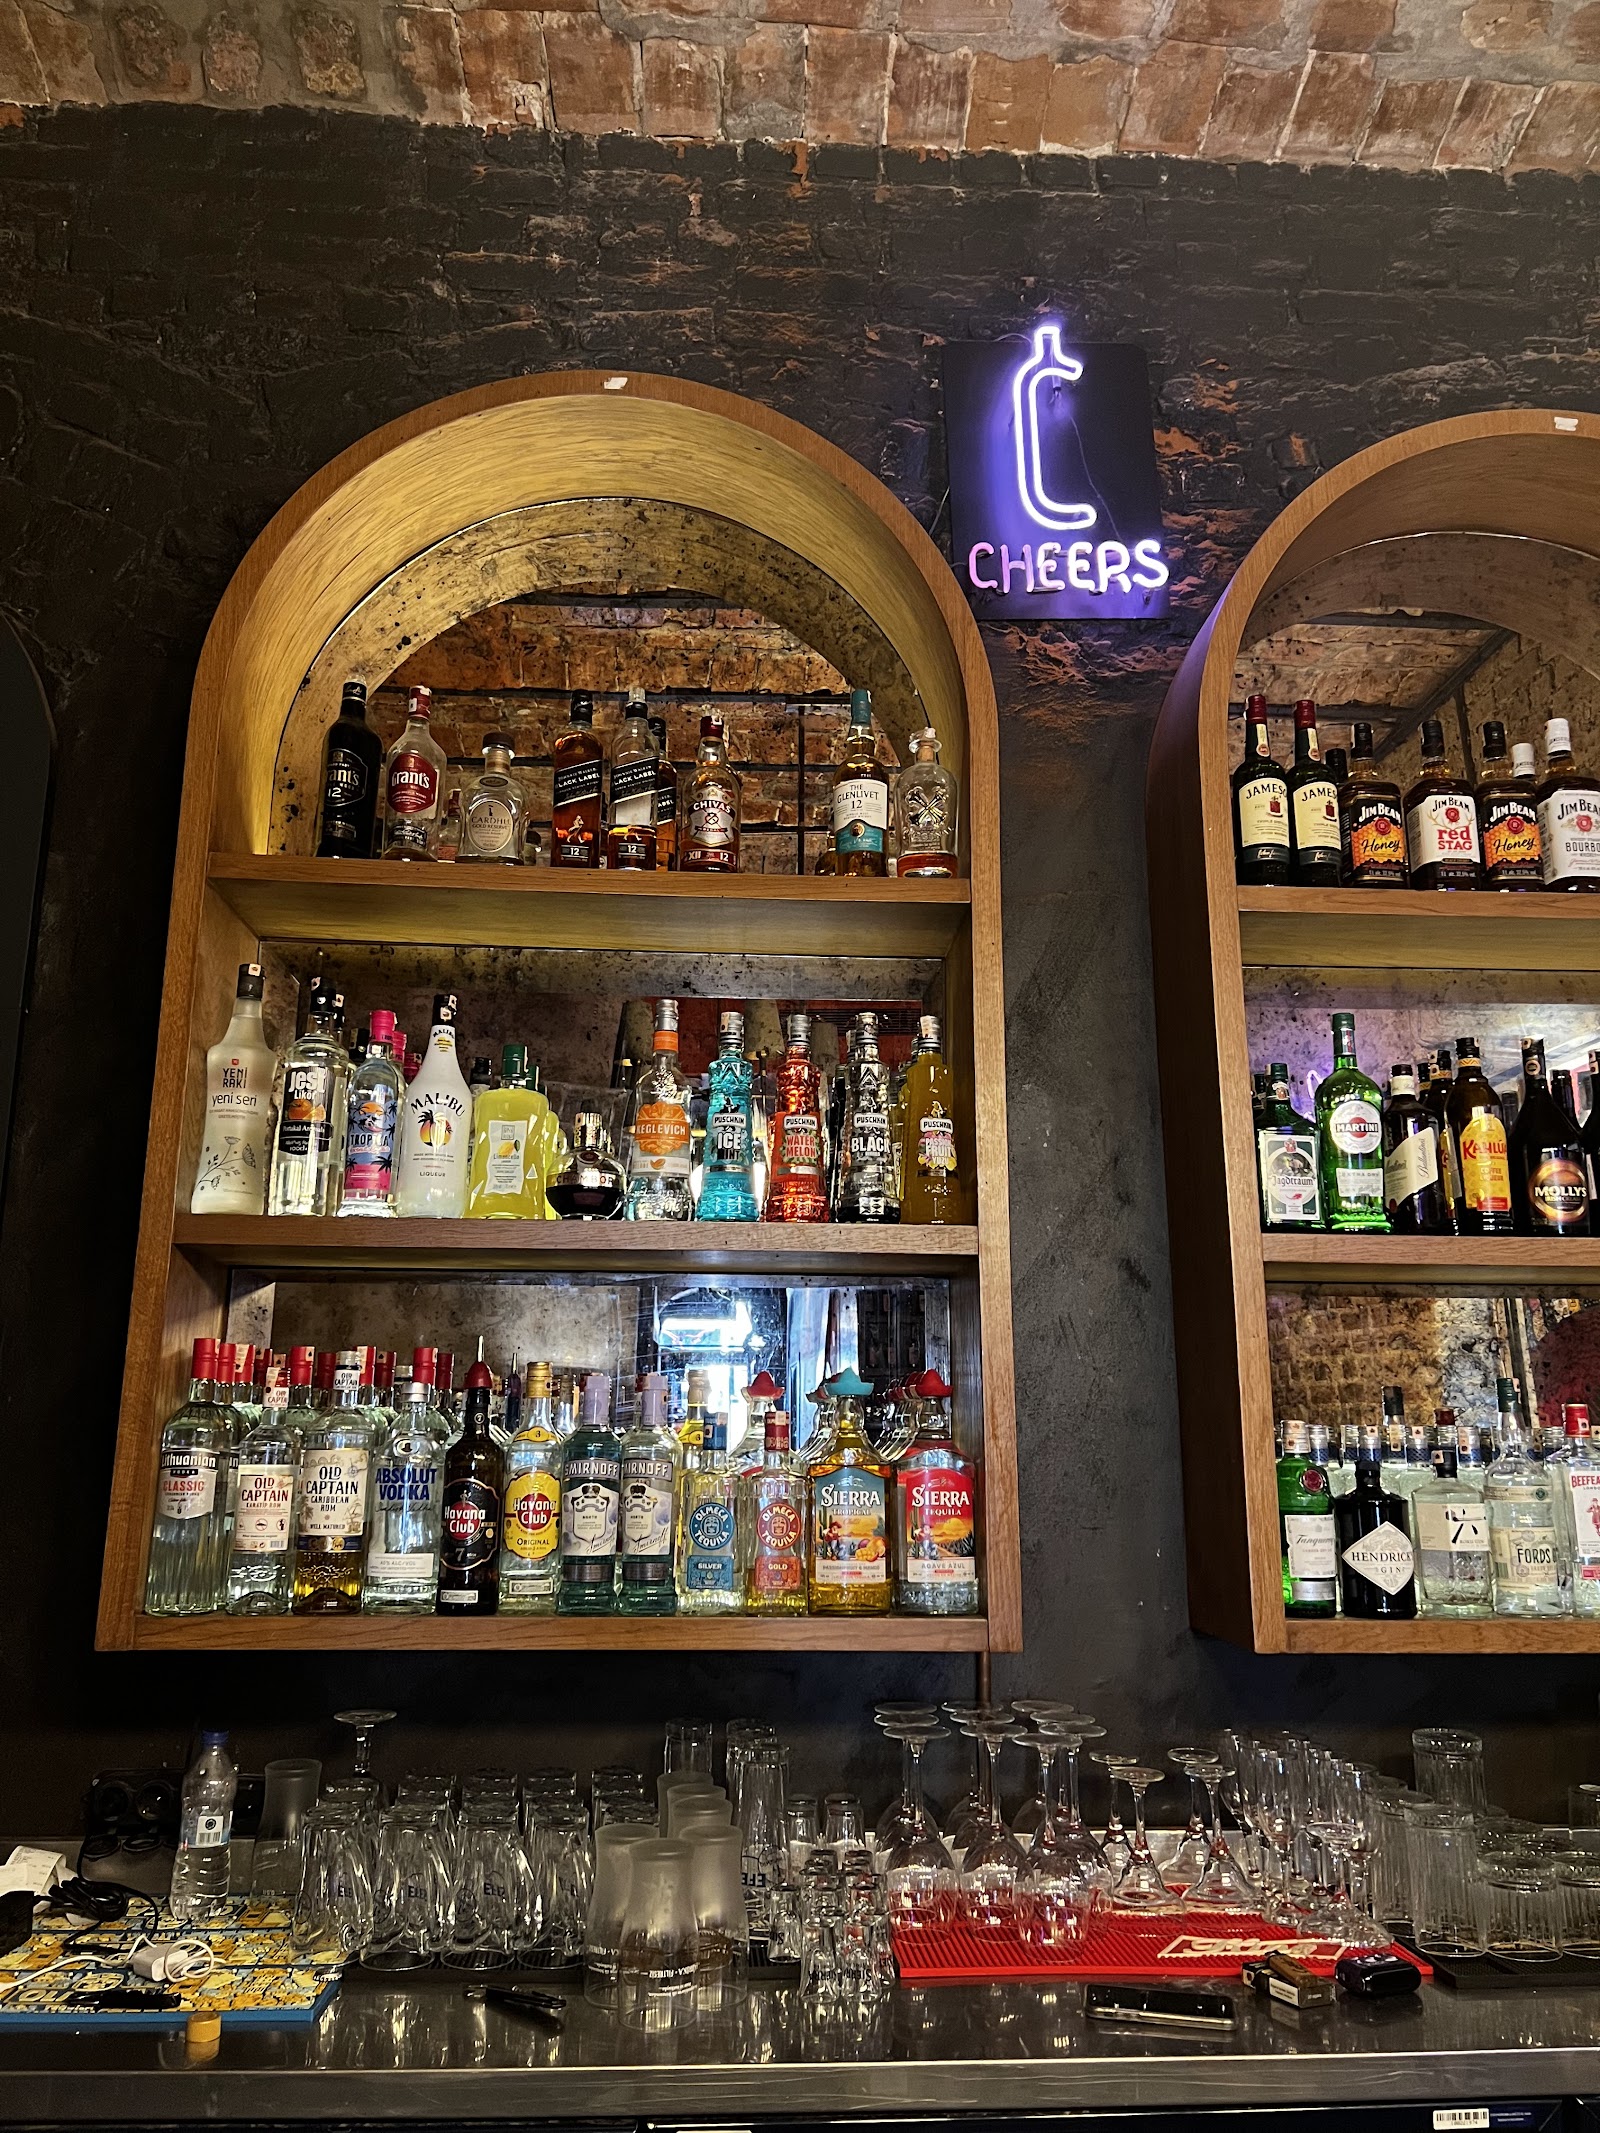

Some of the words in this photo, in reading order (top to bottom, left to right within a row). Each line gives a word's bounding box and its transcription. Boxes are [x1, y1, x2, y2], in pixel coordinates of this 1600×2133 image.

[968, 540, 1168, 593] CHEERS
[329, 769, 359, 787] ant's
[578, 772, 601, 783] LABEL
[633, 769, 657, 780] LABEL
[850, 783, 864, 791] THE
[657, 799, 675, 808] ABEL
[837, 790, 880, 804] GLENLIVET
[851, 799, 863, 810] 12
[692, 800, 732, 814] CHIVAS
[1432, 799, 1450, 813] JIM
[1450, 797, 1470, 813] BEAM
[1490, 805, 1509, 822] JIM
[1508, 802, 1536, 822] BEAM
[1557, 802, 1578, 821] JIM
[1578, 798, 1600, 813] BEA
[1358, 805, 1377, 823] JIM
[1377, 803, 1402, 823] BEAM
[1437, 825, 1472, 841] red
[570, 847, 580, 856] 12
[627, 844, 637, 854] 12
[1361, 838, 1402, 854] Honey
[1438, 840, 1473, 851] STAG
[1493, 837, 1538, 854] Honey
[1565, 841, 1600, 853] BOURBO
[719, 851, 730, 862] 12
[212, 1091, 234, 1108] yeni
[236, 1094, 258, 1107] seri
[410, 1092, 467, 1118] MALIBU
[785, 1116, 816, 1127] PUSCHKIN
[856, 1116, 887, 1125] PUSCHKIN
[1336, 1123, 1379, 1132] MARTINI
[636, 1123, 686, 1136] KEGLEVICH
[718, 1131, 742, 1150] ICE
[786, 1134, 816, 1147] WATER
[851, 1136, 890, 1154] BLACK
[786, 1146, 817, 1158] MELON
[318, 1466, 342, 1481] OLD
[375, 1467, 438, 1485] ABSOLUT
[564, 1461, 619, 1477] SMIRNOFF
[625, 1461, 669, 1477] IRNOFF
[162, 1480, 205, 1492] CLASSIC
[254, 1477, 276, 1490] OLD
[305, 1480, 359, 1496] CAPTAIN
[241, 1489, 290, 1503] CAPTAIN
[378, 1484, 431, 1501] VODKA
[820, 1484, 881, 1508] SIERRA
[911, 1484, 971, 1508] SIERRA
[320, 1504, 337, 1512] RUM
[444, 1505, 487, 1521] Havana
[514, 1498, 558, 1513] Havana
[924, 1508, 963, 1516] TEQUILA
[520, 1511, 548, 1526] Club
[694, 1504, 730, 1523] OLMECA
[761, 1504, 796, 1523] OLMECA
[449, 1515, 476, 1534] Club
[516, 1537, 550, 1546] ORIGINAL
[693, 1529, 730, 1548] TEQUILA
[761, 1529, 797, 1548] TEQUILA
[1351, 1551, 1413, 1564] HENDRICK
[1517, 1548, 1551, 1564] FORDS
[697, 1562, 723, 1570] SILVER
[921, 1561, 945, 1570] AGAVE
[947, 1562, 966, 1570] AZUL
[1381, 1565, 1402, 1574] GIN
[742, 1872, 766, 1888] EFE
